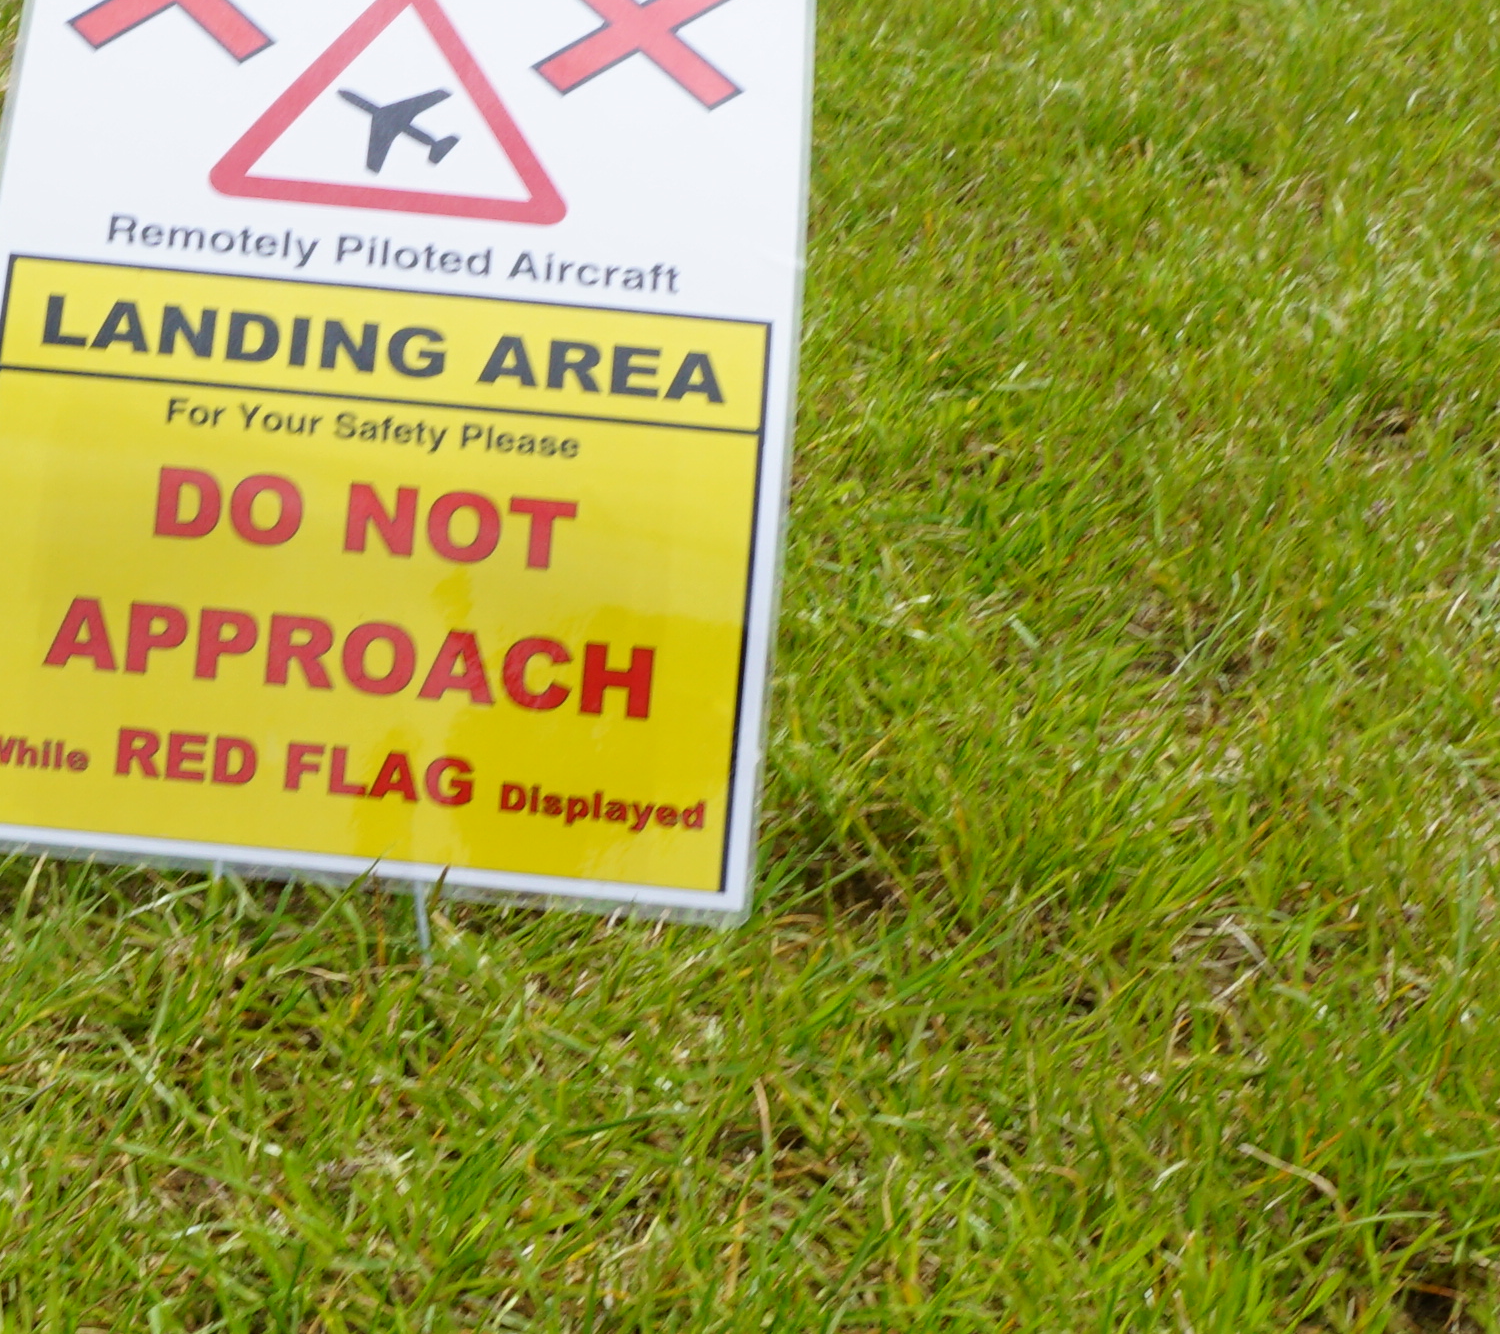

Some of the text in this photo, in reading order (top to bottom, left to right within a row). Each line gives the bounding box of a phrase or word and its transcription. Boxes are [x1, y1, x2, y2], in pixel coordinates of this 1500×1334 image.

[106, 213, 682, 295] Remotely Piloted Aircraft
[41, 294, 726, 405] LANDING AREA
[166, 397, 580, 460] For Your Safety Please
[153, 465, 577, 570] DO NOT
[43, 597, 656, 719] APPROACH
[115, 728, 257, 786] RED
[284, 743, 475, 808] FLAG
[499, 782, 706, 832] Displayed
